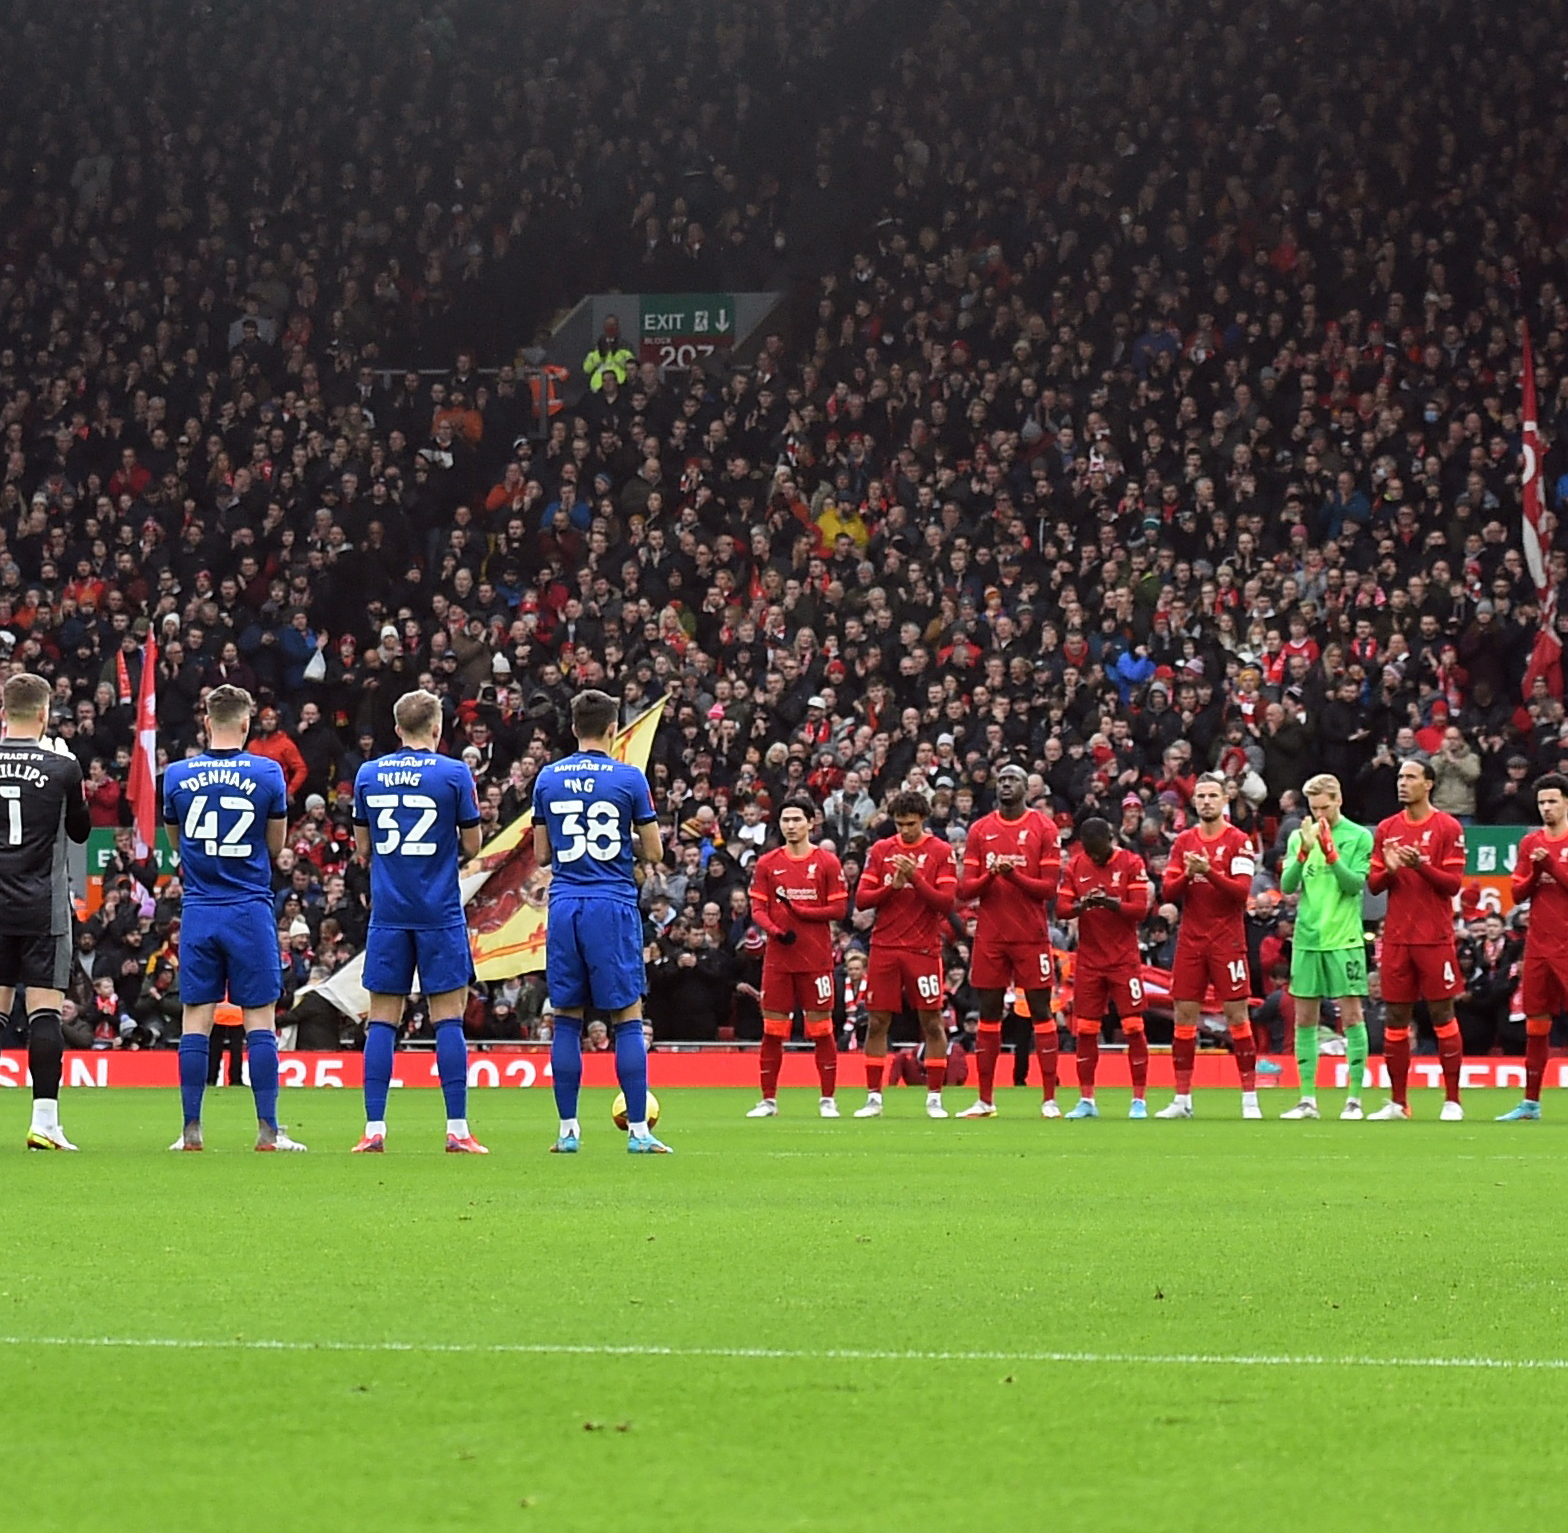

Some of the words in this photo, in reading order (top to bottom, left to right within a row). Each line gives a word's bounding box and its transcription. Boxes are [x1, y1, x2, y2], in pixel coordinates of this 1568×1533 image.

[644, 313, 685, 331] EXIT
[187, 768, 257, 796] DENHAM
[383, 770, 422, 788] KING
[571, 777, 596, 794] NG
[0, 785, 22, 845] 1
[184, 795, 256, 857] 42
[365, 794, 438, 856] 32
[549, 799, 622, 863] 38
[1038, 953, 1050, 975] 5
[1226, 959, 1246, 983] 14
[1443, 961, 1455, 983] 4
[814, 975, 832, 998] 18
[917, 974, 940, 998] 66
[1128, 977, 1142, 1000] 8
